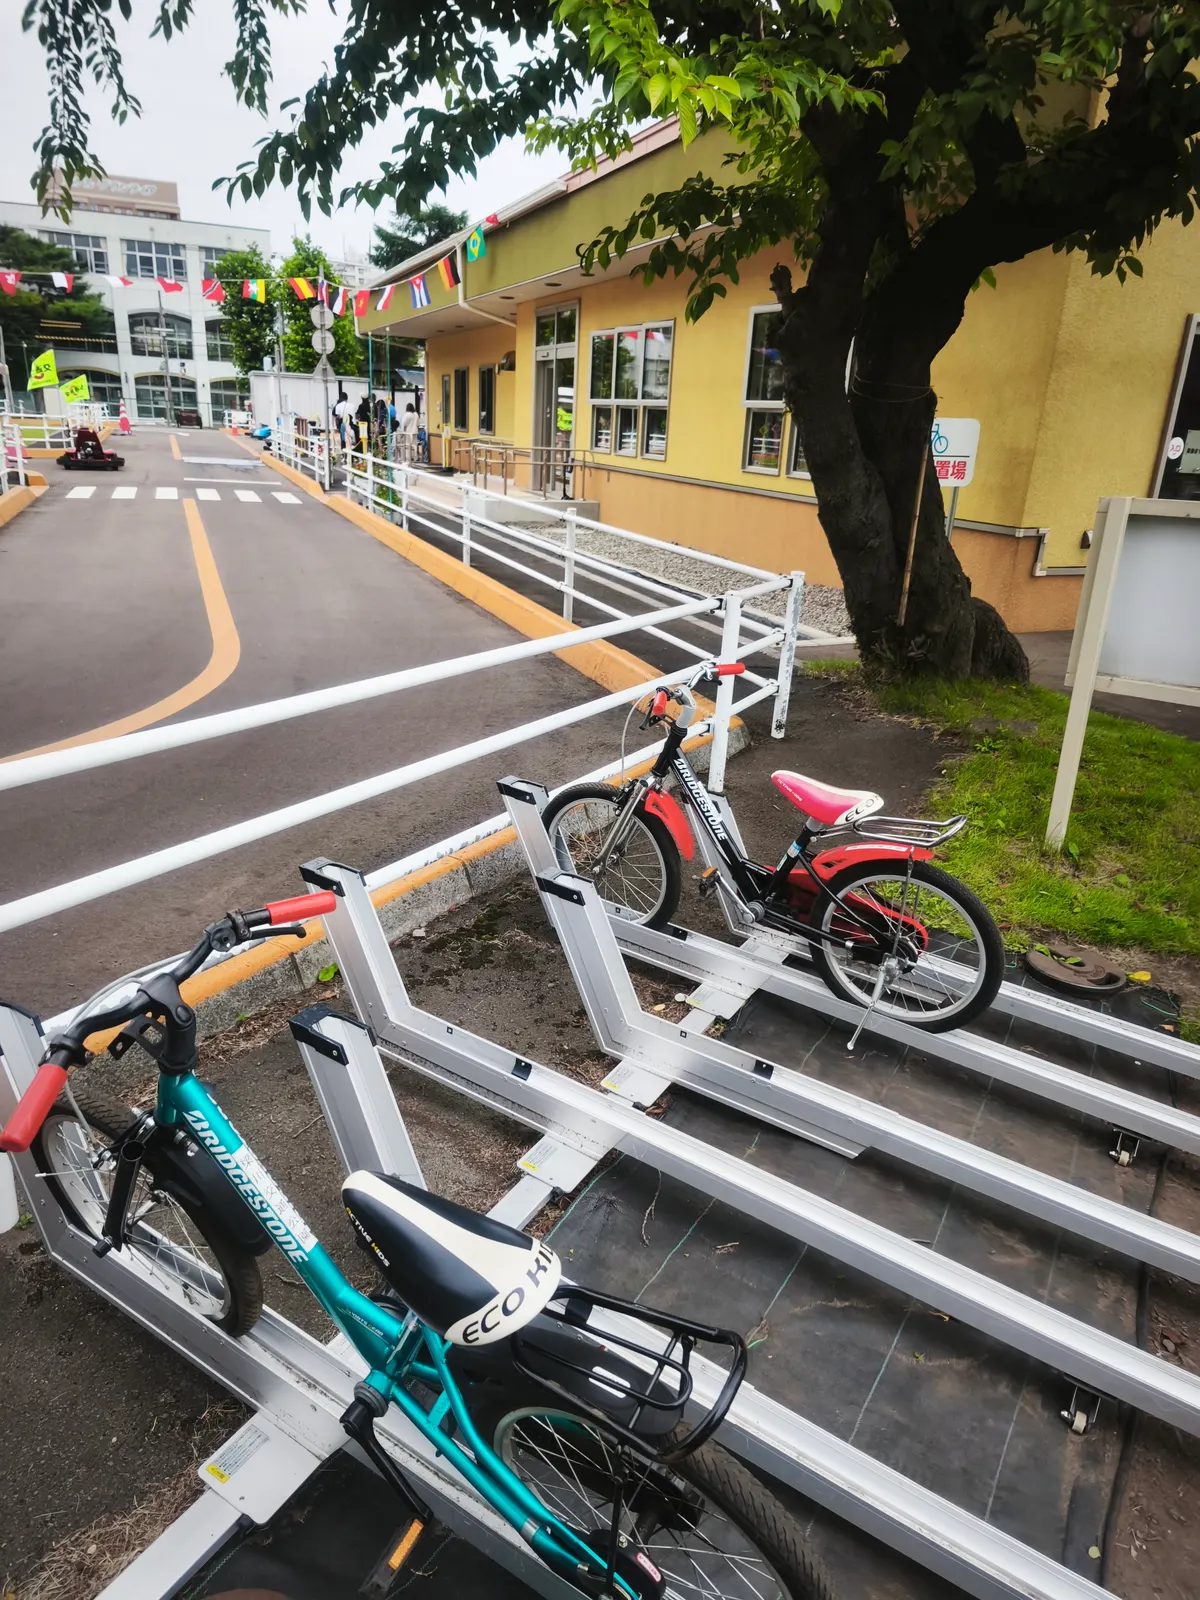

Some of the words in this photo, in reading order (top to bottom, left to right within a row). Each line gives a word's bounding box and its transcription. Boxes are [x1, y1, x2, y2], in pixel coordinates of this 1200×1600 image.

[935, 460, 967, 480] 置場
[673, 758, 728, 841] BRIDGESTONE
[183, 1110, 309, 1264] BRIDGESTONE
[345, 1207, 372, 1244] ACTIVE
[370, 1241, 390, 1267] KIDS
[462, 1287, 526, 1344] ECO
